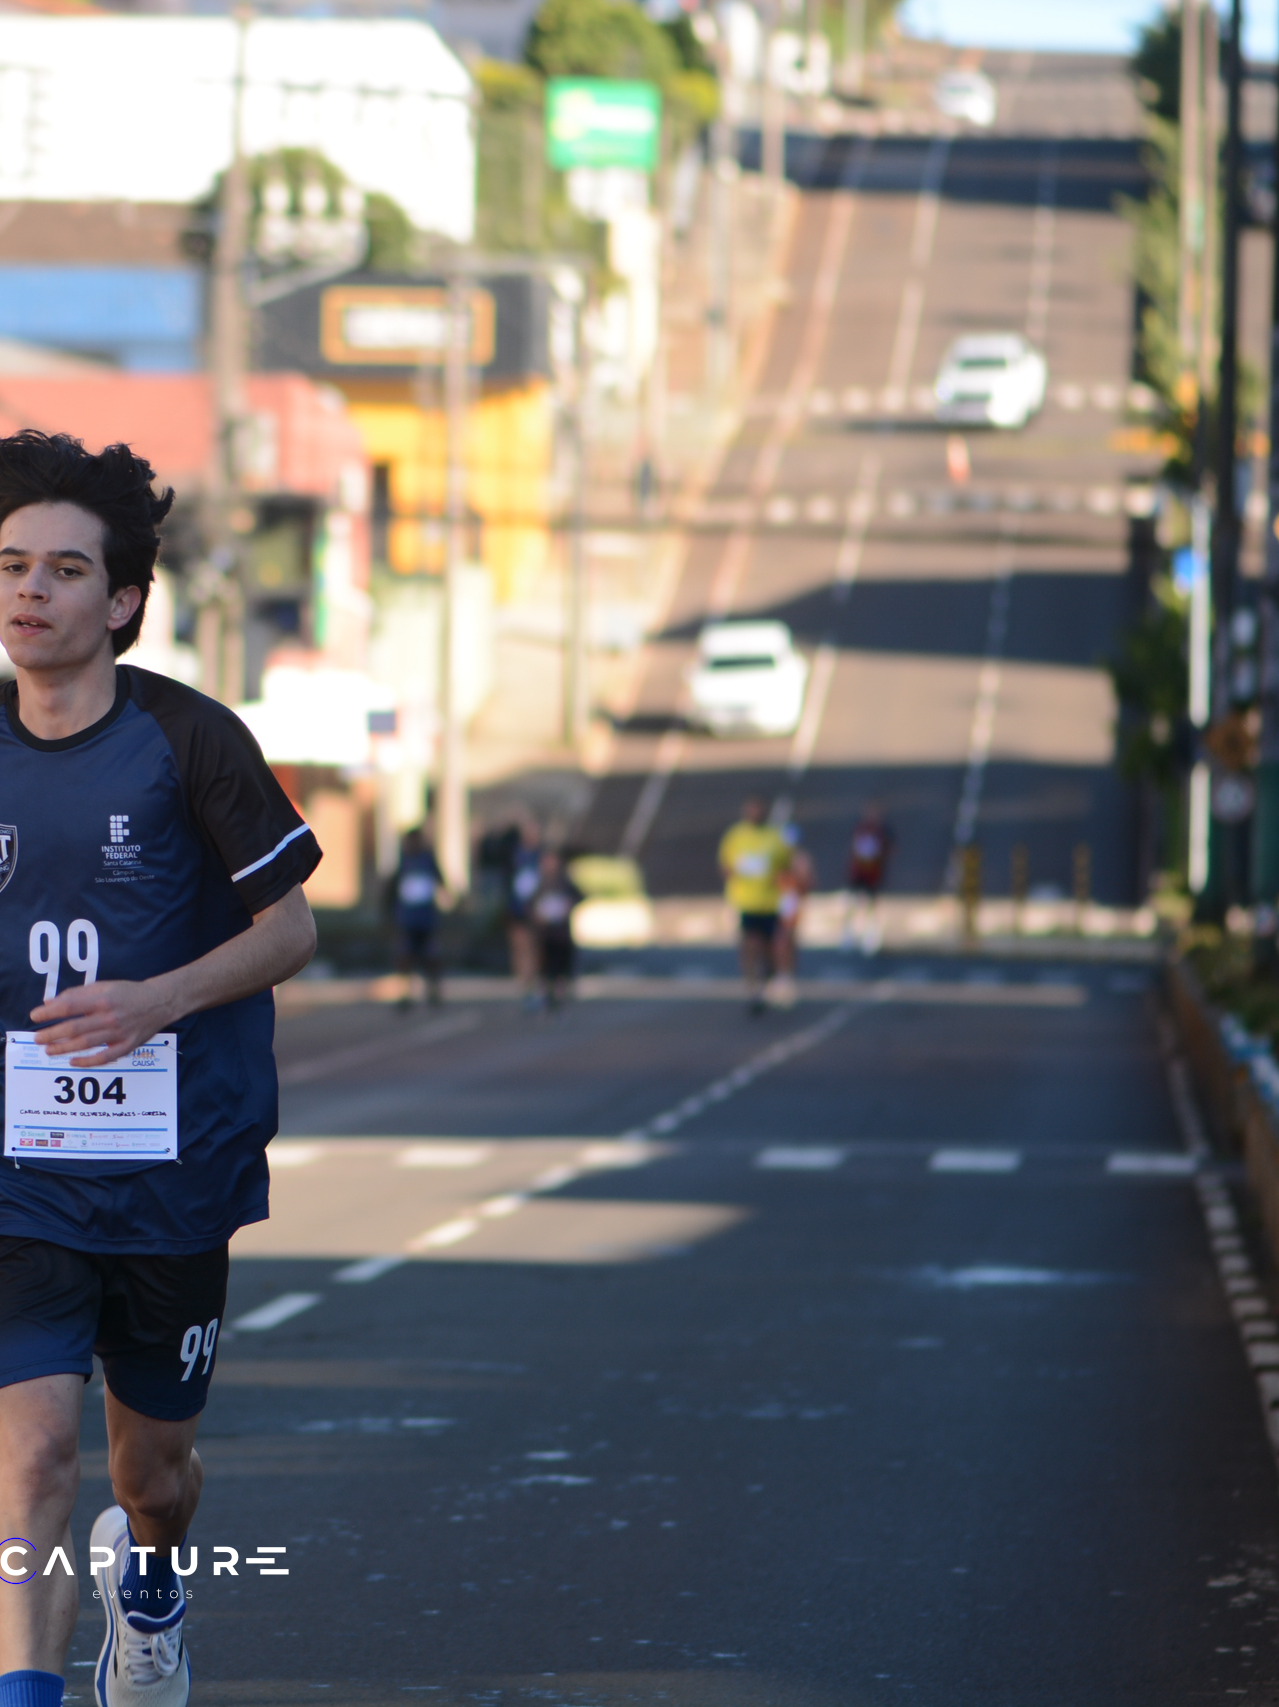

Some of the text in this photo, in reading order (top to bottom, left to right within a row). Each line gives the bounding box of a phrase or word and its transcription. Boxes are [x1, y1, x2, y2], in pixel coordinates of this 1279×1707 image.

[29, 918, 99, 1001] 99
[53, 1075, 127, 1105] 304
[179, 1317, 219, 1382] 99
